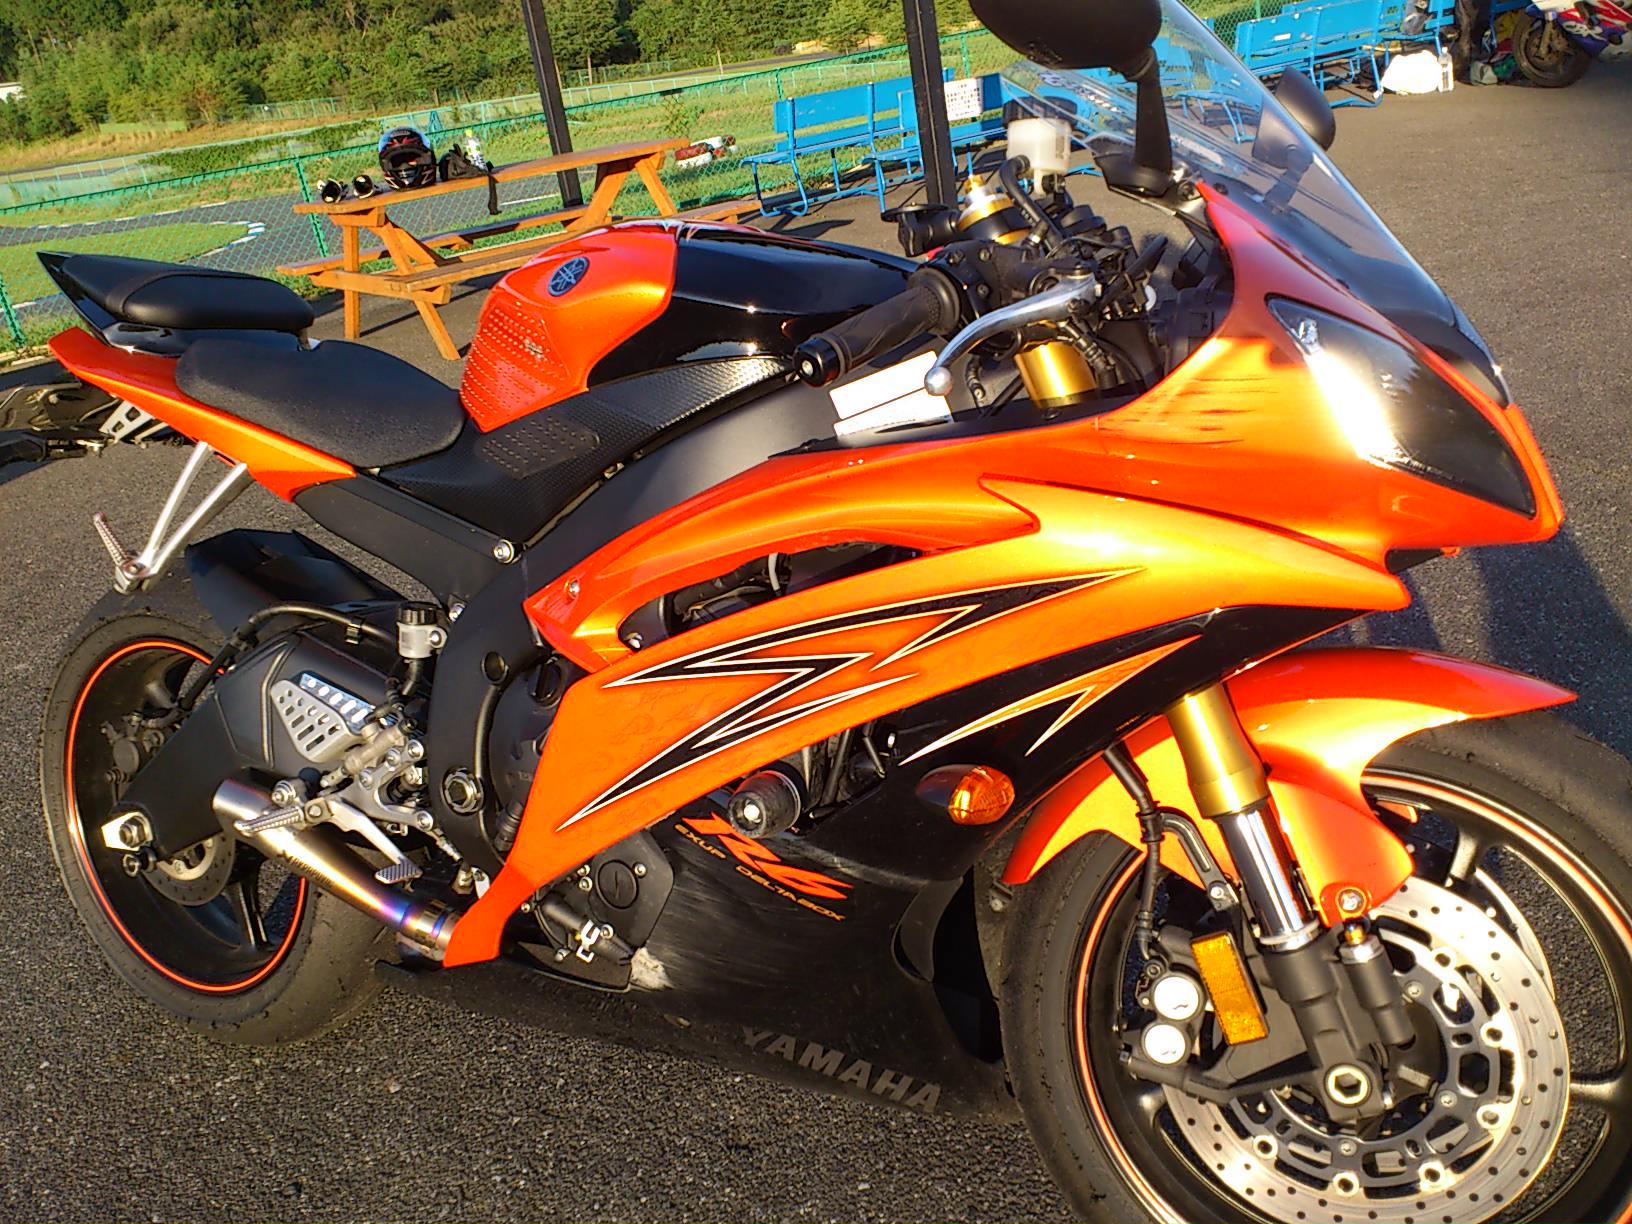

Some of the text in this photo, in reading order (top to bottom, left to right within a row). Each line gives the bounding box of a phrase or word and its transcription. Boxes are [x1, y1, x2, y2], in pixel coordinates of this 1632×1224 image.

[674, 823, 847, 921] EXUP DELTABOX
[741, 1026, 942, 1112] YAMAHA
